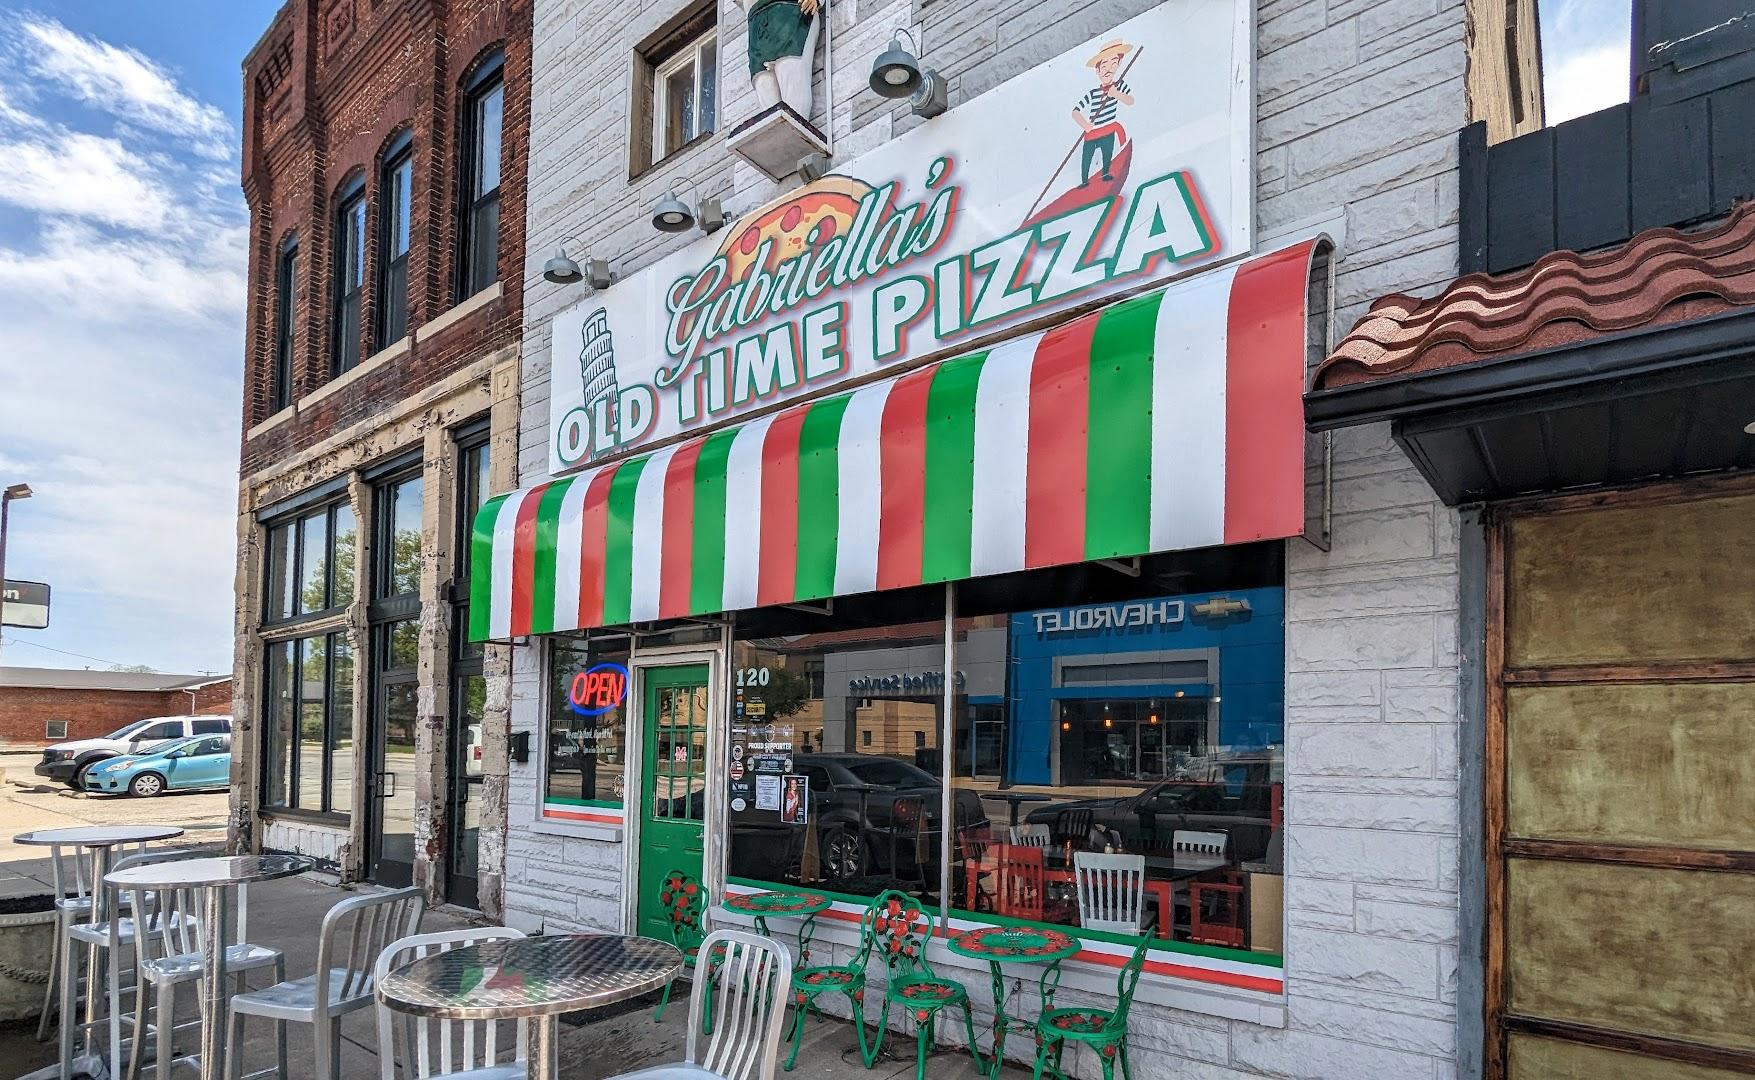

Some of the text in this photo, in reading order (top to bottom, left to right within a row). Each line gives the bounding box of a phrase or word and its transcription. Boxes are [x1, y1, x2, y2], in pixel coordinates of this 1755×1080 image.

[655, 157, 957, 388] Gabriella's
[557, 171, 1220, 465] OLD TIME PIZZA
[572, 672, 624, 707] OPEN
[736, 667, 770, 687] 120
[764, 742, 792, 750] SUPPORTER
